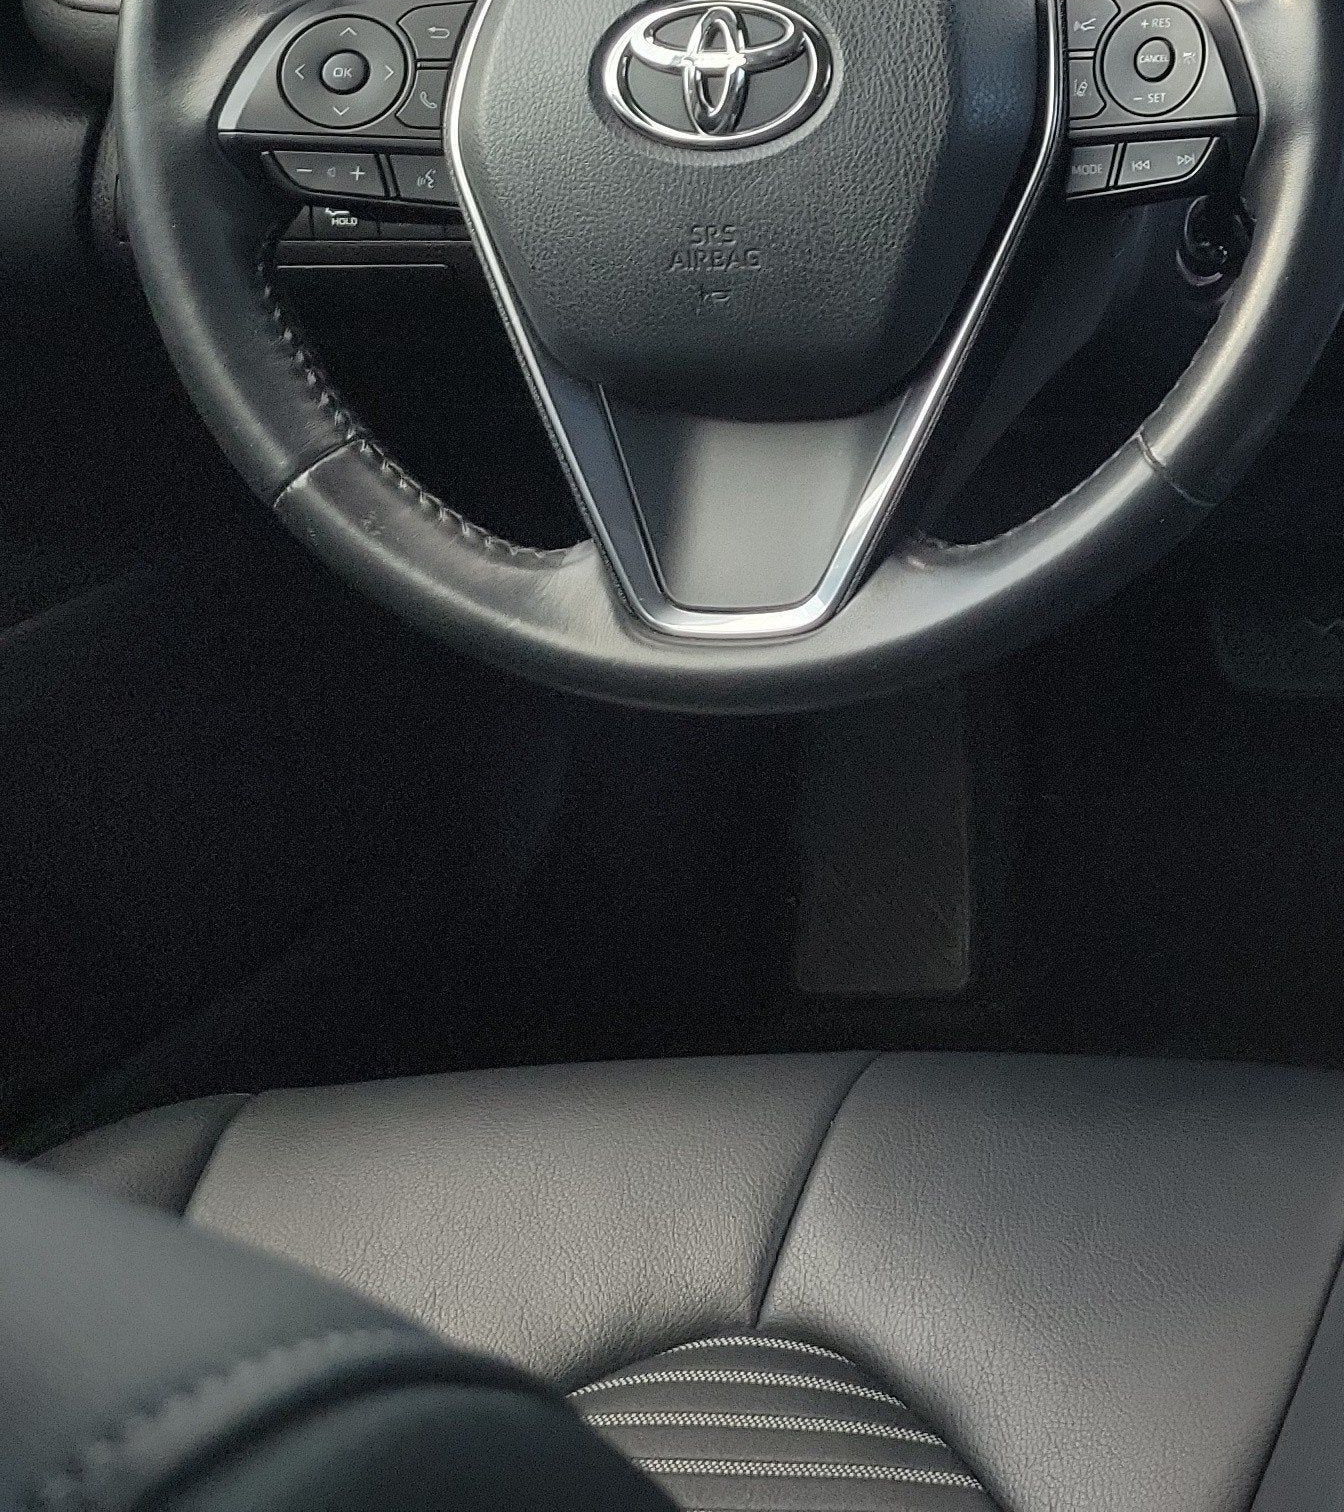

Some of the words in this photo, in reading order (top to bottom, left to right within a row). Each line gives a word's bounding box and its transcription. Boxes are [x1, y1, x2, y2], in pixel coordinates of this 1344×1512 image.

[1151, 18, 1171, 28] RES
[1139, 55, 1170, 64] CANCEL
[333, 67, 352, 78] OK
[1147, 93, 1166, 103] SET
[1071, 164, 1102, 175] MODE
[331, 217, 358, 226] HOLD
[690, 225, 737, 246] SRS
[667, 249, 761, 271] AIRBAG
